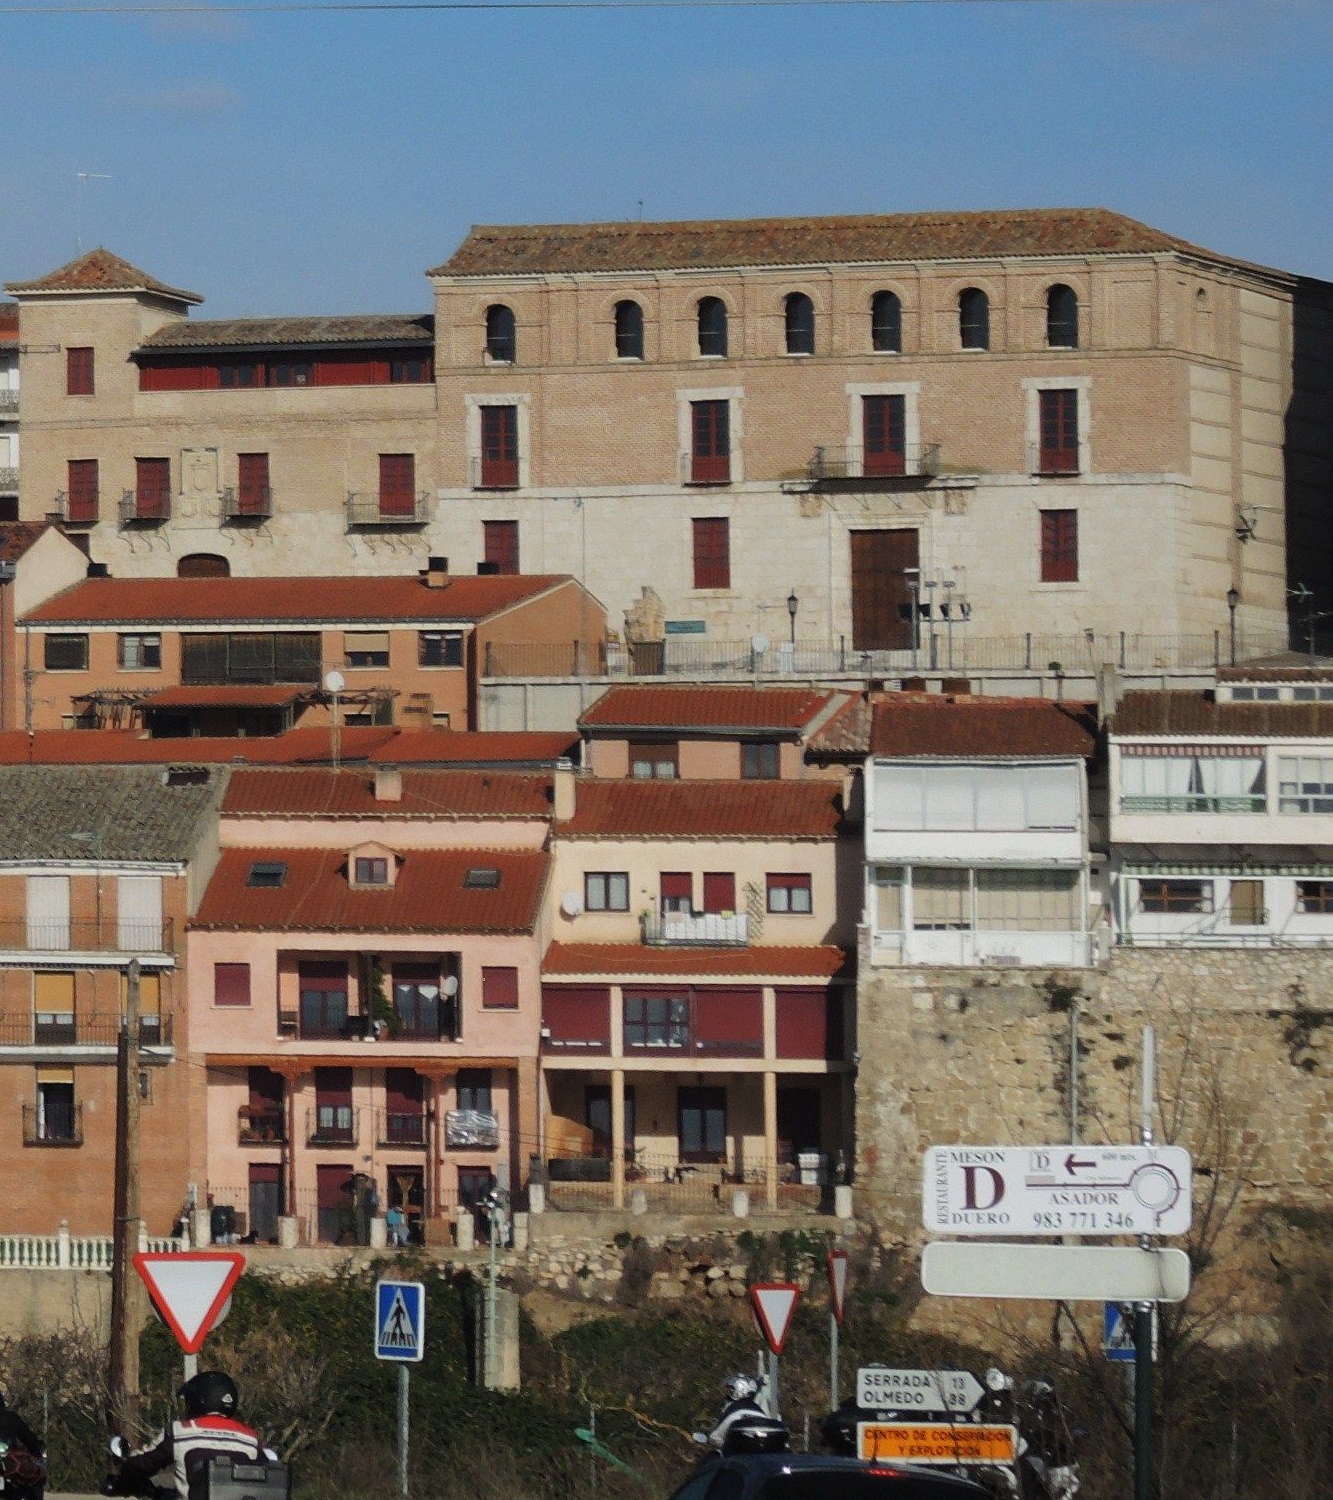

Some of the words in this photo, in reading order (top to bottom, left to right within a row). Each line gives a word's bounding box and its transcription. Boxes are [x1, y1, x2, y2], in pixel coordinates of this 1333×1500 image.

[950, 1151, 1005, 1164] MESON
[935, 1150, 949, 1225] RESTAURANTE
[959, 1165, 1005, 1211] D
[1048, 1192, 1120, 1206] ASADOR
[952, 1212, 1011, 1225] DUERO
[1033, 1212, 1063, 1229] 983
[1069, 1212, 1097, 1228] 771
[1103, 1212, 1134, 1228] 346
[864, 1373, 931, 1389] SERRADA
[951, 1377, 966, 1390] 13
[863, 1390, 925, 1404] OLMEDO
[864, 1429, 909, 1440] CENTRO
[913, 1429, 926, 1440] DE
